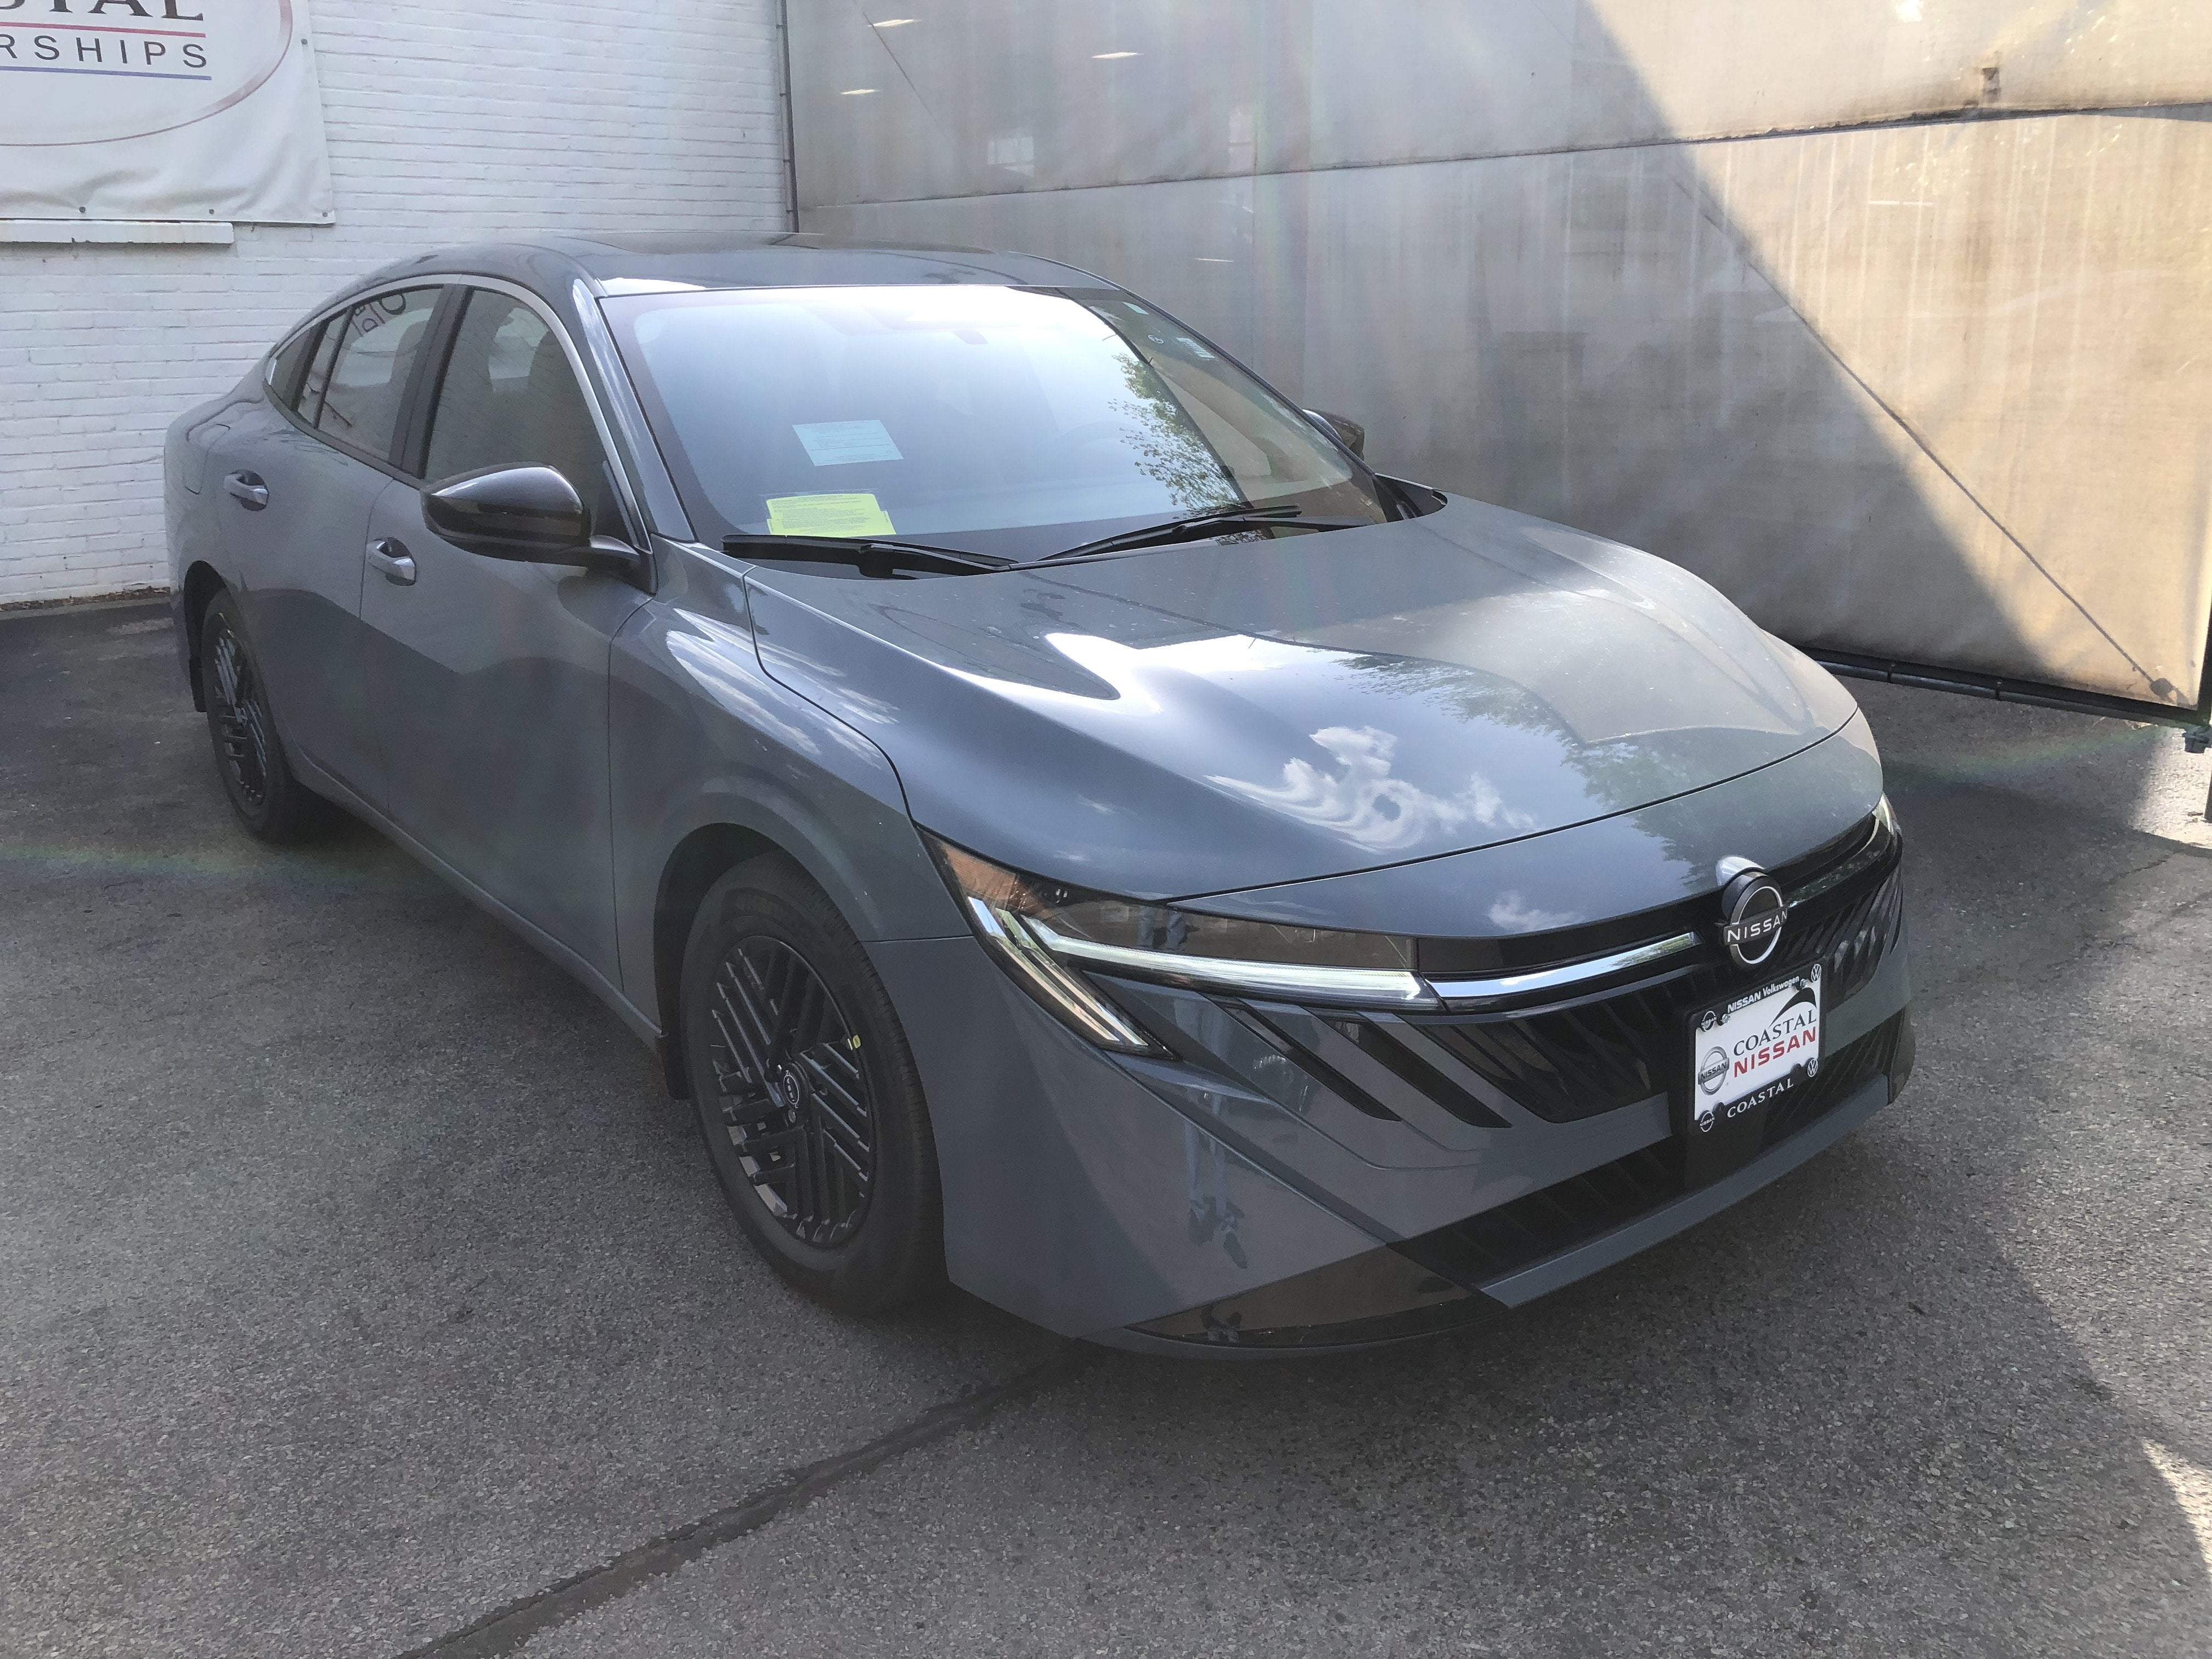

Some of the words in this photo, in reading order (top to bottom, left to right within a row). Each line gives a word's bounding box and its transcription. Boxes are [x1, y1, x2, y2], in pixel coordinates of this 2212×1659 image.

[1727, 908, 1788, 943] NISSAN
[1728, 991, 1761, 1013] NISSAN
[1763, 975, 1799, 997] Volkswagen
[1734, 1009, 1817, 1056] COASTAL
[1734, 1026, 1816, 1078] NISSAN
[1701, 1062, 1727, 1080] NISSAN
[1728, 1078, 1794, 1118] COASTAL
